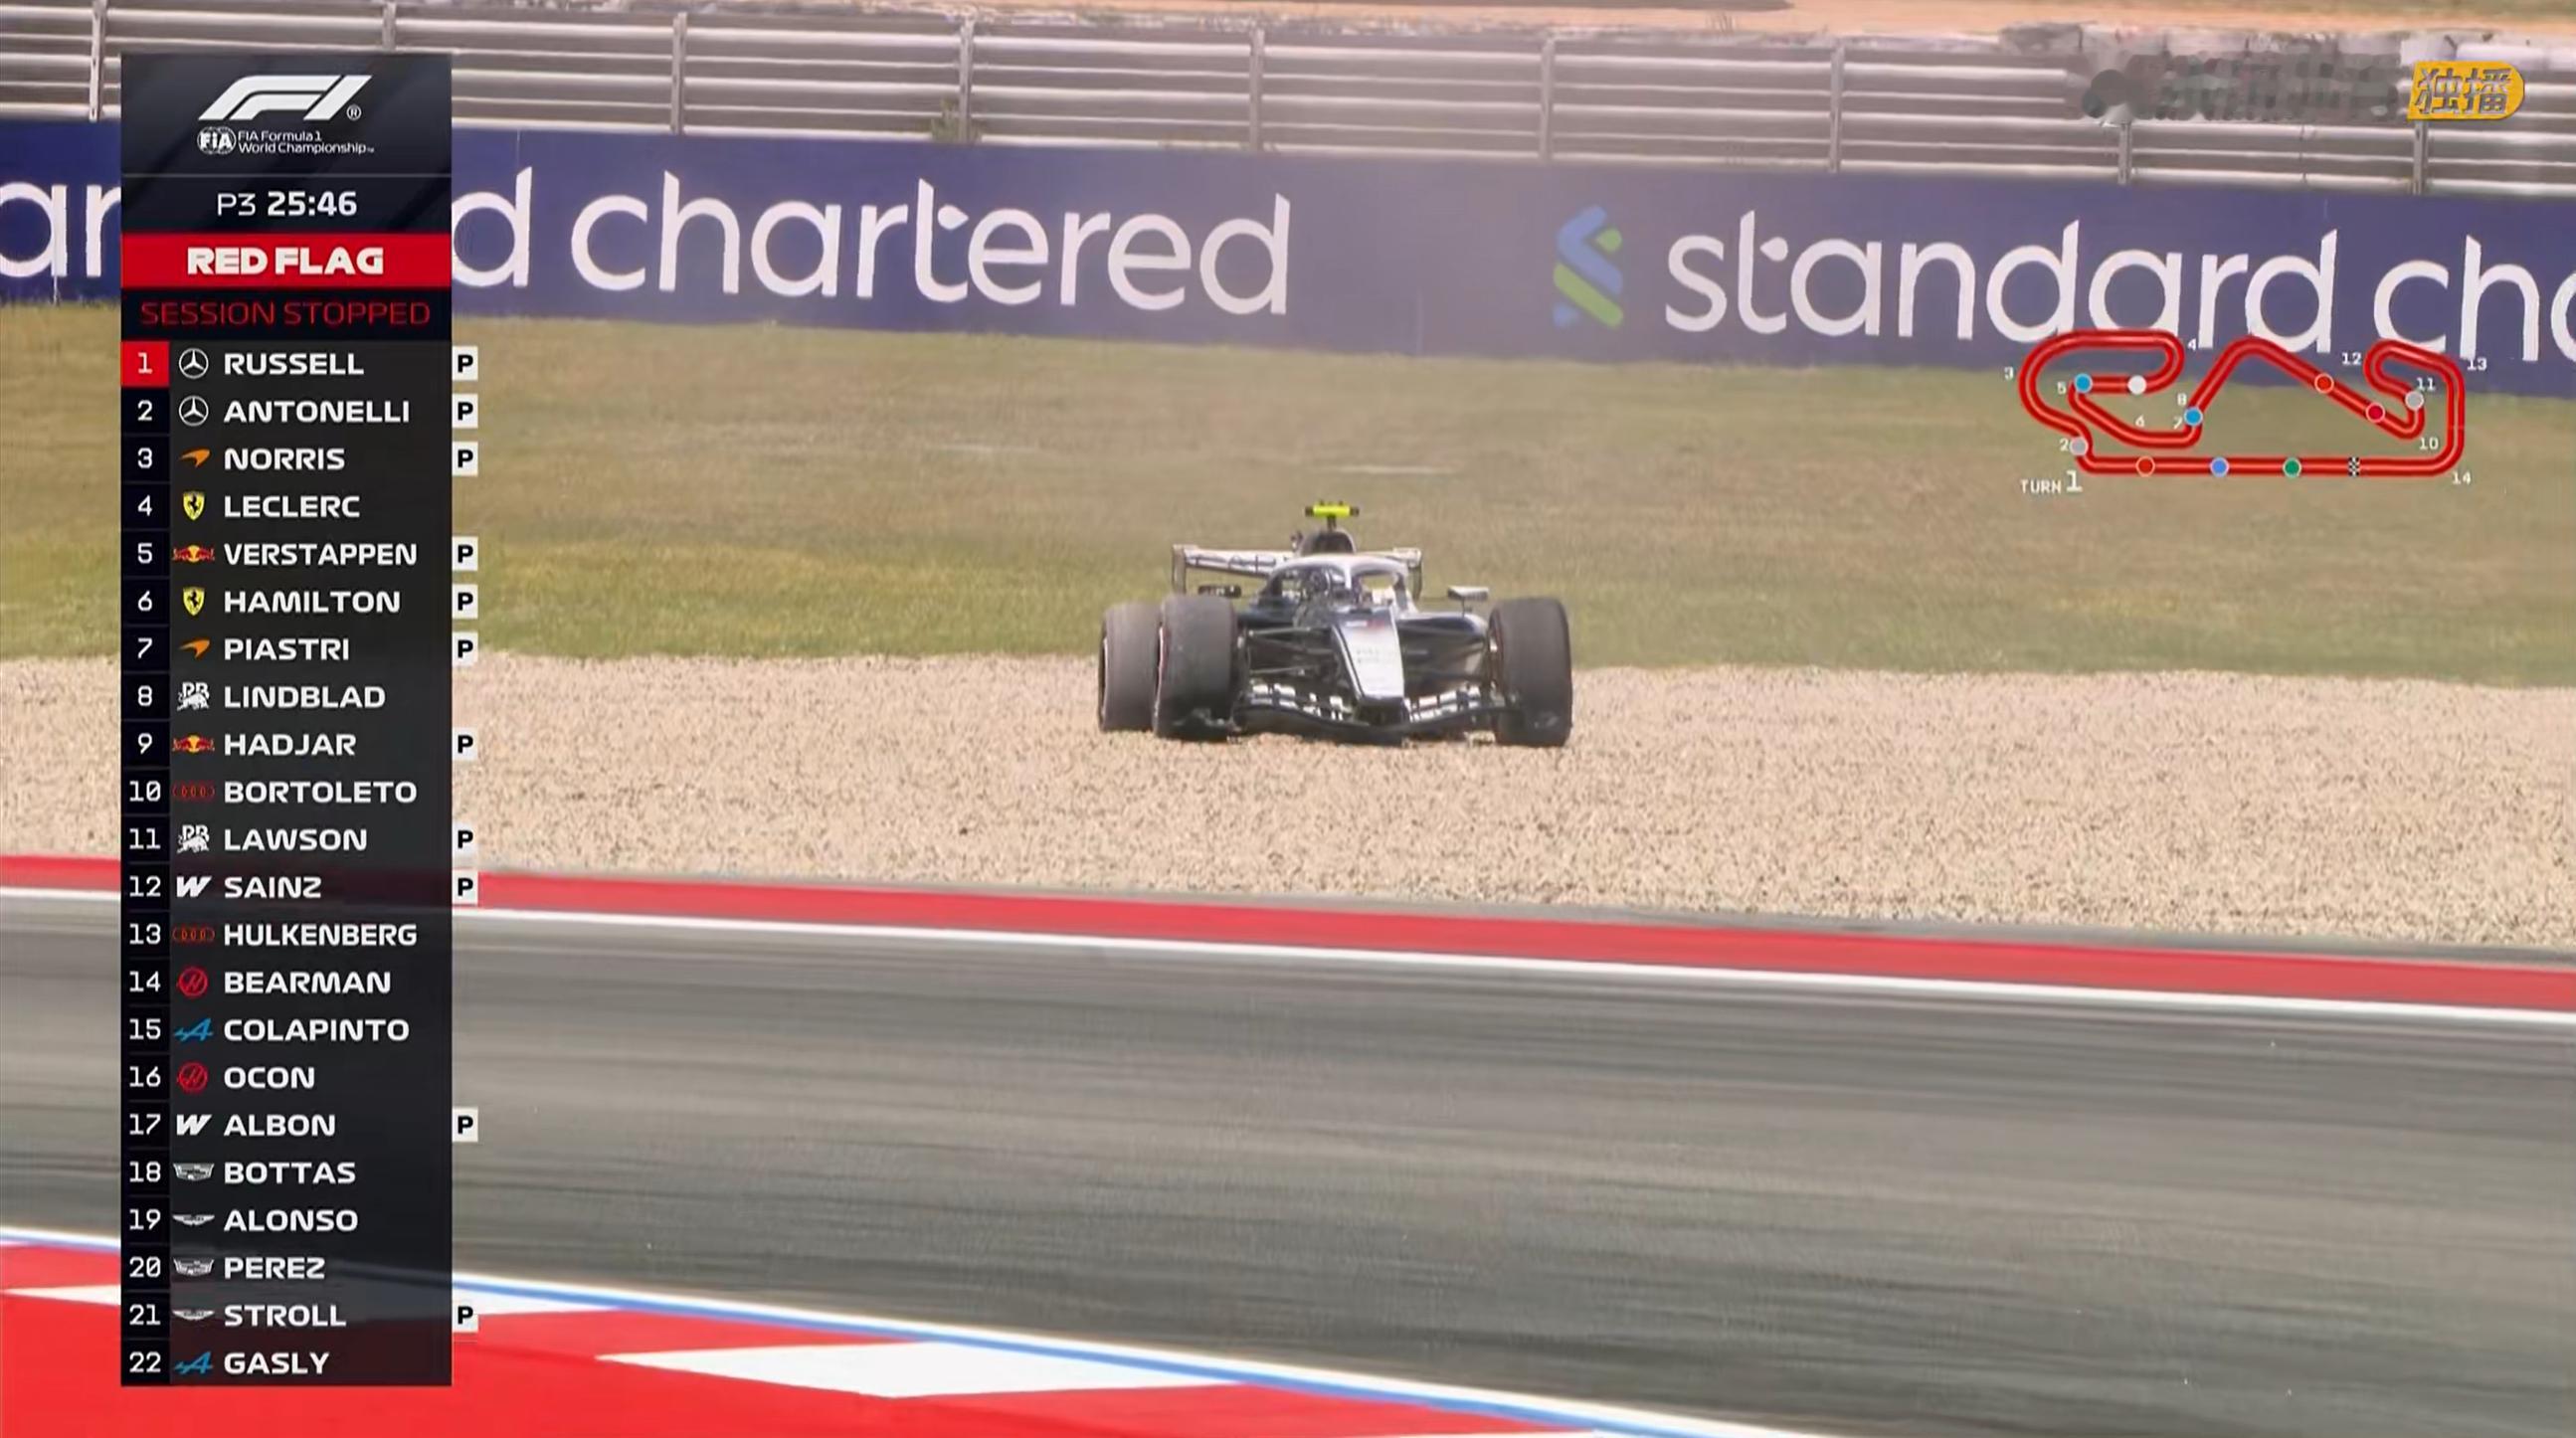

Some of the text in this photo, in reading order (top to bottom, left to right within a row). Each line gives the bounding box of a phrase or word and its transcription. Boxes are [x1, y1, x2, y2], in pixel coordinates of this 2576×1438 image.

[571, 167, 1291, 316] chartered
[1664, 209, 2576, 364] standard ch
